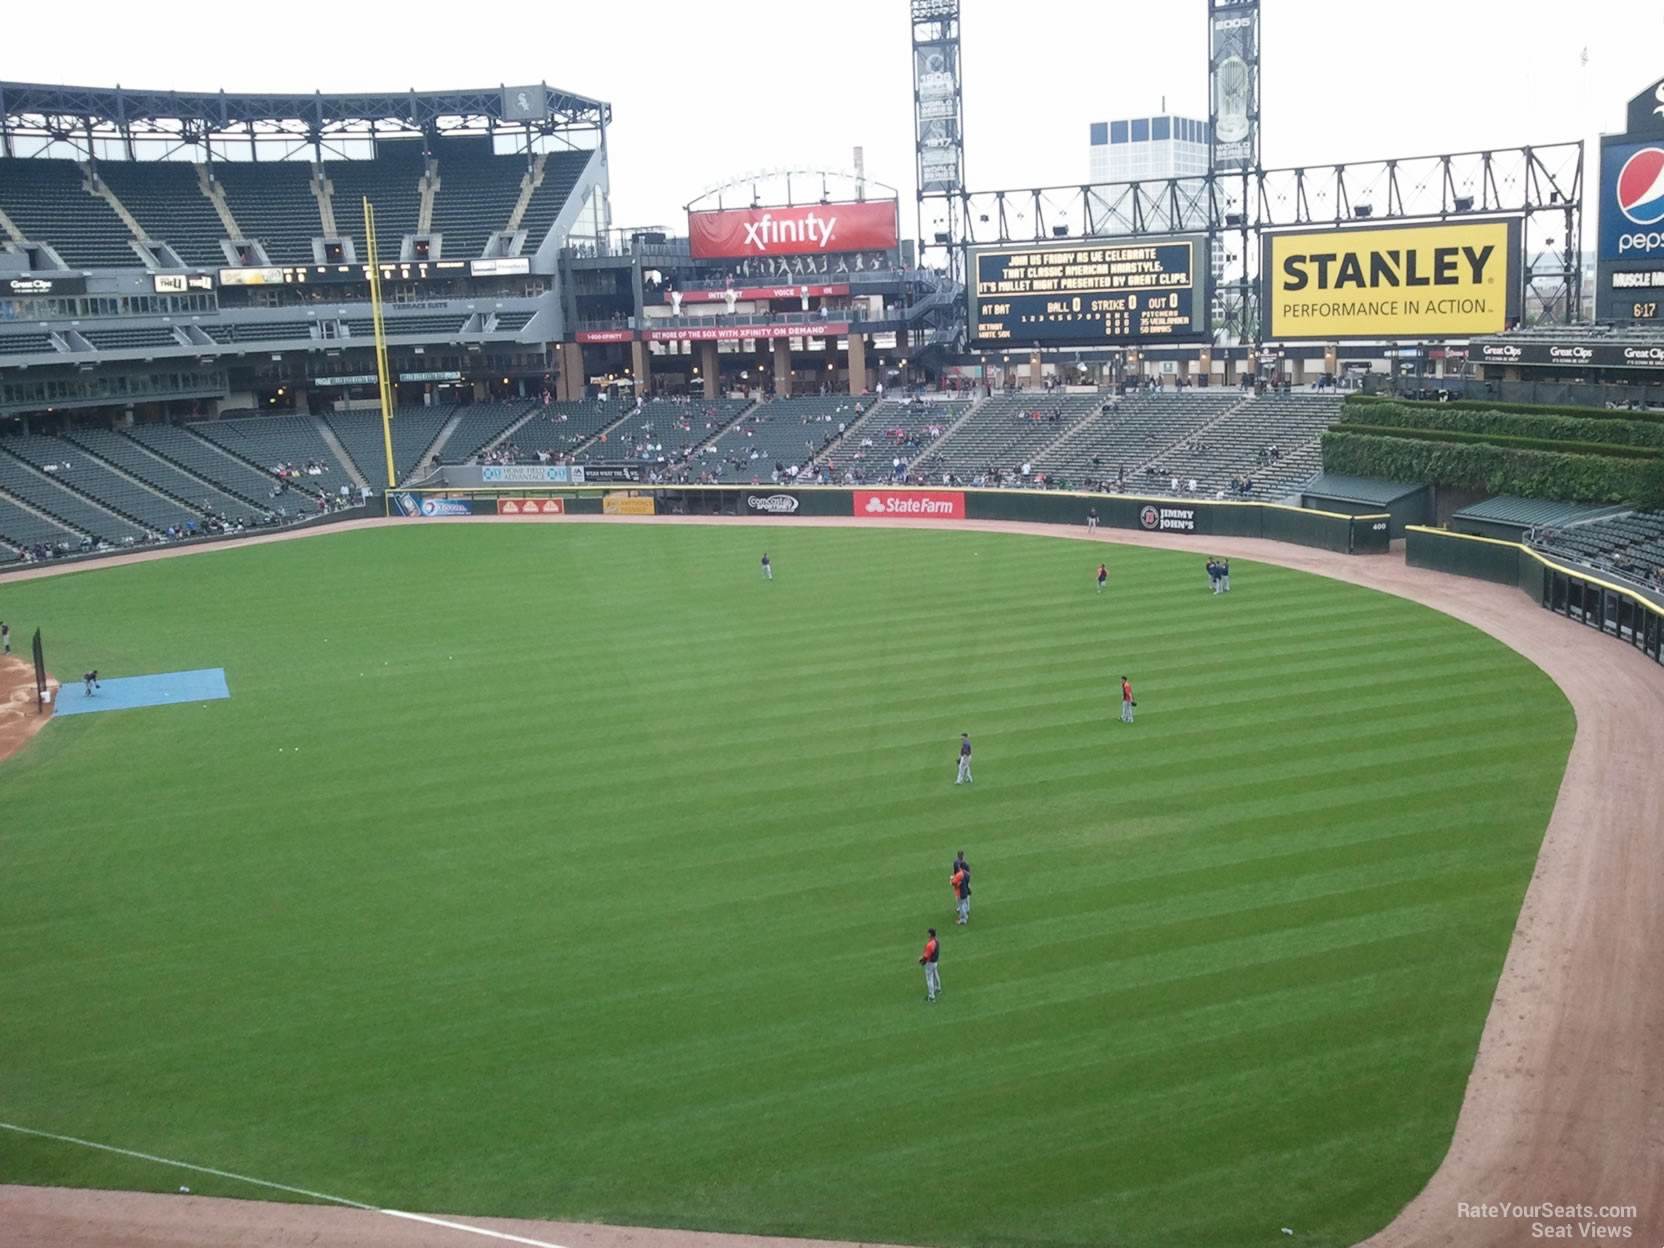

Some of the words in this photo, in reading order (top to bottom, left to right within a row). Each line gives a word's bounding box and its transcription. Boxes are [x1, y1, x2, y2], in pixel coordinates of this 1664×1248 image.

[1215, 17, 1250, 30] 2005
[925, 137, 952, 147] 1917
[1216, 142, 1250, 150] WORLD
[924, 165, 955, 174] WORLD
[744, 212, 837, 250] xfinity
[1008, 255, 1028, 266] JOIN
[1030, 254, 1042, 265] US
[1043, 252, 1075, 265] FRIDAY
[1076, 251, 1089, 262] AS
[1090, 250, 1103, 262] WE
[1105, 248, 1156, 261] CELEBRATE
[1003, 267, 1025, 279] THAT
[1027, 265, 1063, 278] CLASSIC
[1065, 263, 1109, 277] AMERICAN
[1283, 245, 1495, 291] STANLEY
[10, 280, 32, 289] Great
[33, 279, 52, 290] Clips
[980, 281, 997, 293] IT'S
[999, 280, 1030, 292] MULLET
[1032, 278, 1058, 290] NIGHT
[1060, 276, 1110, 289] PRESENTED
[1113, 275, 1126, 287] BY
[1128, 274, 1156, 286] GREAT
[1612, 272, 1651, 287] MUSCLE
[773, 288, 795, 297] VOICE
[1047, 302, 1069, 313] BALL
[1072, 297, 1081, 312] 0
[1091, 300, 1125, 311] STRIKE
[1128, 295, 1137, 310] 0
[1148, 298, 1166, 309] OUT
[1169, 293, 1178, 308] 0
[982, 305, 993, 316] AT
[994, 304, 1010, 315] BAT
[1283, 301, 1398, 318] PERFORMANCE
[1404, 301, 1420, 315] IN
[1425, 299, 1486, 314] ACTION
[1633, 303, 1656, 317] 6:17
[1139, 318, 1149, 326] 35
[662, 331, 678, 339] MORE
[688, 330, 700, 338] THE
[702, 330, 717, 338] SOX
[718, 329, 738, 337] WITH
[740, 328, 772, 337] XFINITY
[774, 327, 787, 336] ON
[978, 331, 997, 339] WHITE
[997, 330, 1011, 338] SOX
[1139, 326, 1149, 334] 50
[1483, 345, 1503, 355] Great
[1503, 345, 1522, 358] Clips
[1550, 346, 1573, 356] Great
[1573, 346, 1592, 359] Clips
[1624, 347, 1649, 358] Great
[1160, 508, 1194, 519] JIMMY
[1160, 519, 1194, 530] JOHN'S
[1372, 522, 1387, 531] 400
